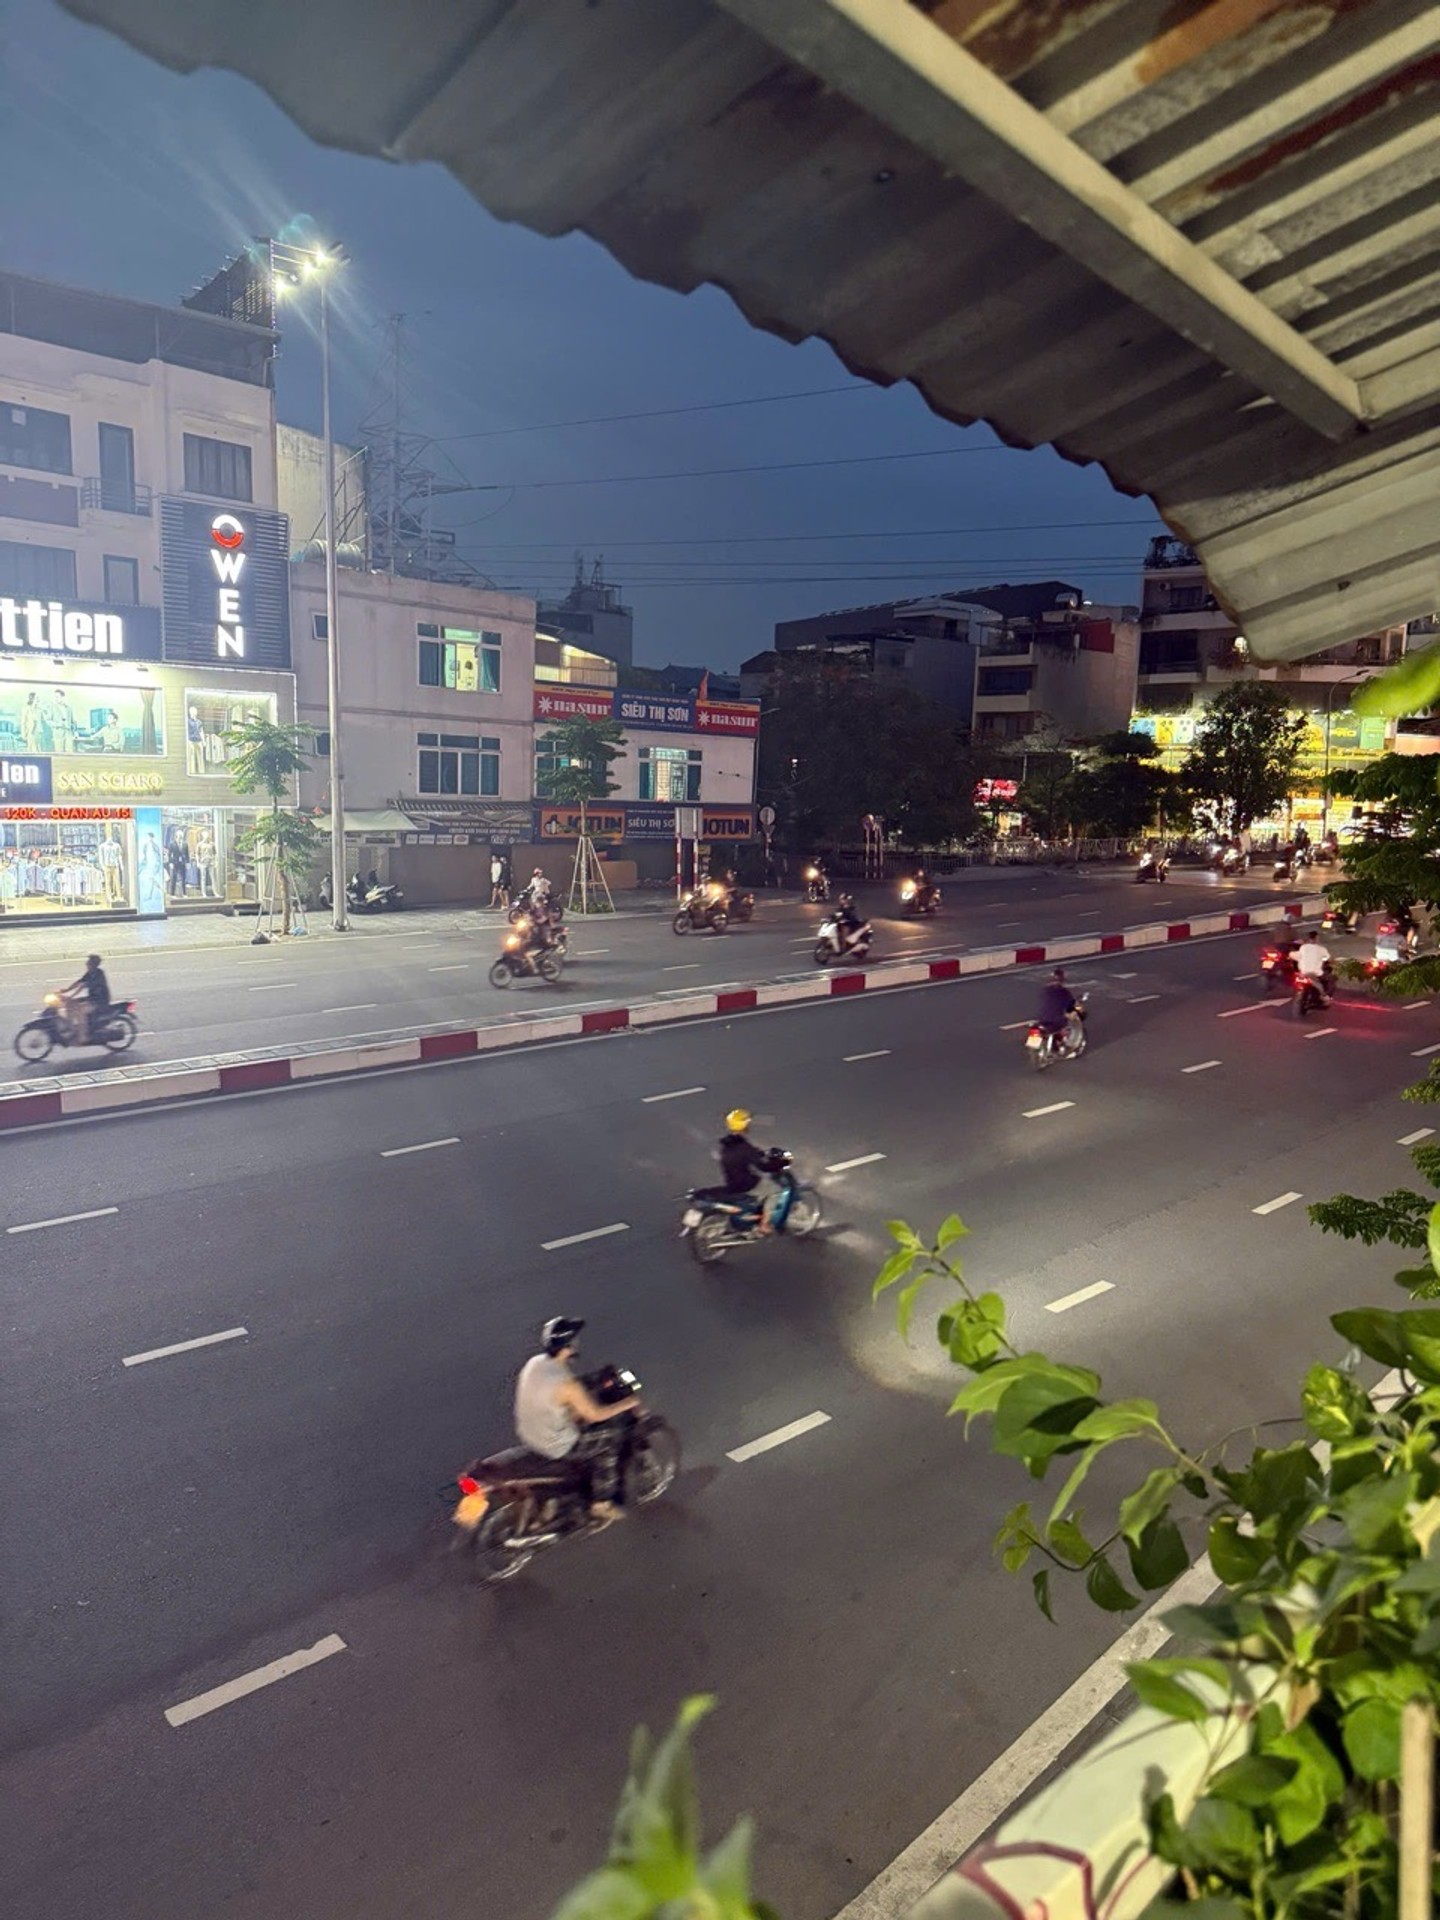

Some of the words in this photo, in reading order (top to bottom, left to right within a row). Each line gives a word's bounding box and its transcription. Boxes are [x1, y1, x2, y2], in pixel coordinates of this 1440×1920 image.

[210, 514, 246, 658] OWEN
[0, 597, 123, 654] ttien
[553, 700, 608, 715] nasun
[621, 700, 646, 719] SIÊU
[649, 705, 665, 722] THỊ
[667, 706, 689, 722] SƠN
[58, 771, 94, 790] SAN
[98, 772, 163, 792] SCIARO
[4, 807, 37, 820] 120K
[50, 807, 89, 820] QUAN
[93, 807, 111, 820] AU
[628, 815, 647, 828] SIÊU
[648, 817, 662, 830] THỊ
